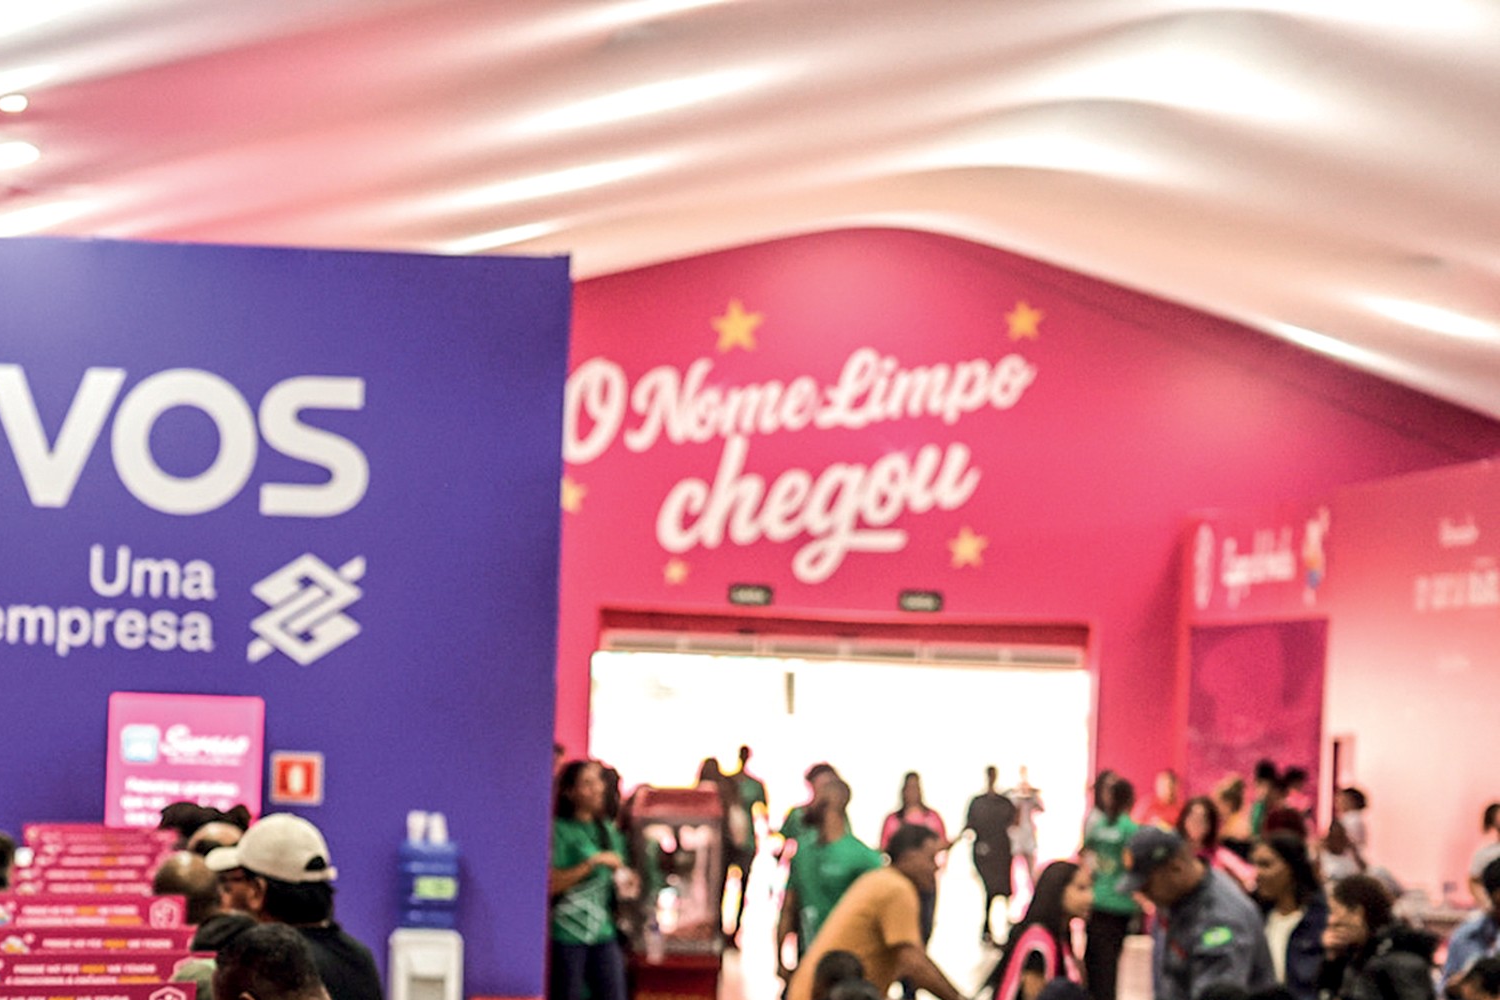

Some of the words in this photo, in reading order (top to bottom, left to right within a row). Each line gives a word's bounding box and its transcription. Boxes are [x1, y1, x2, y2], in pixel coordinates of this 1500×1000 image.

[563, 357, 629, 465] O
[623, 357, 816, 453] Nome
[814, 346, 1037, 430] Limpo
[655, 434, 982, 585] chegou
[88, 544, 218, 601] Uma
